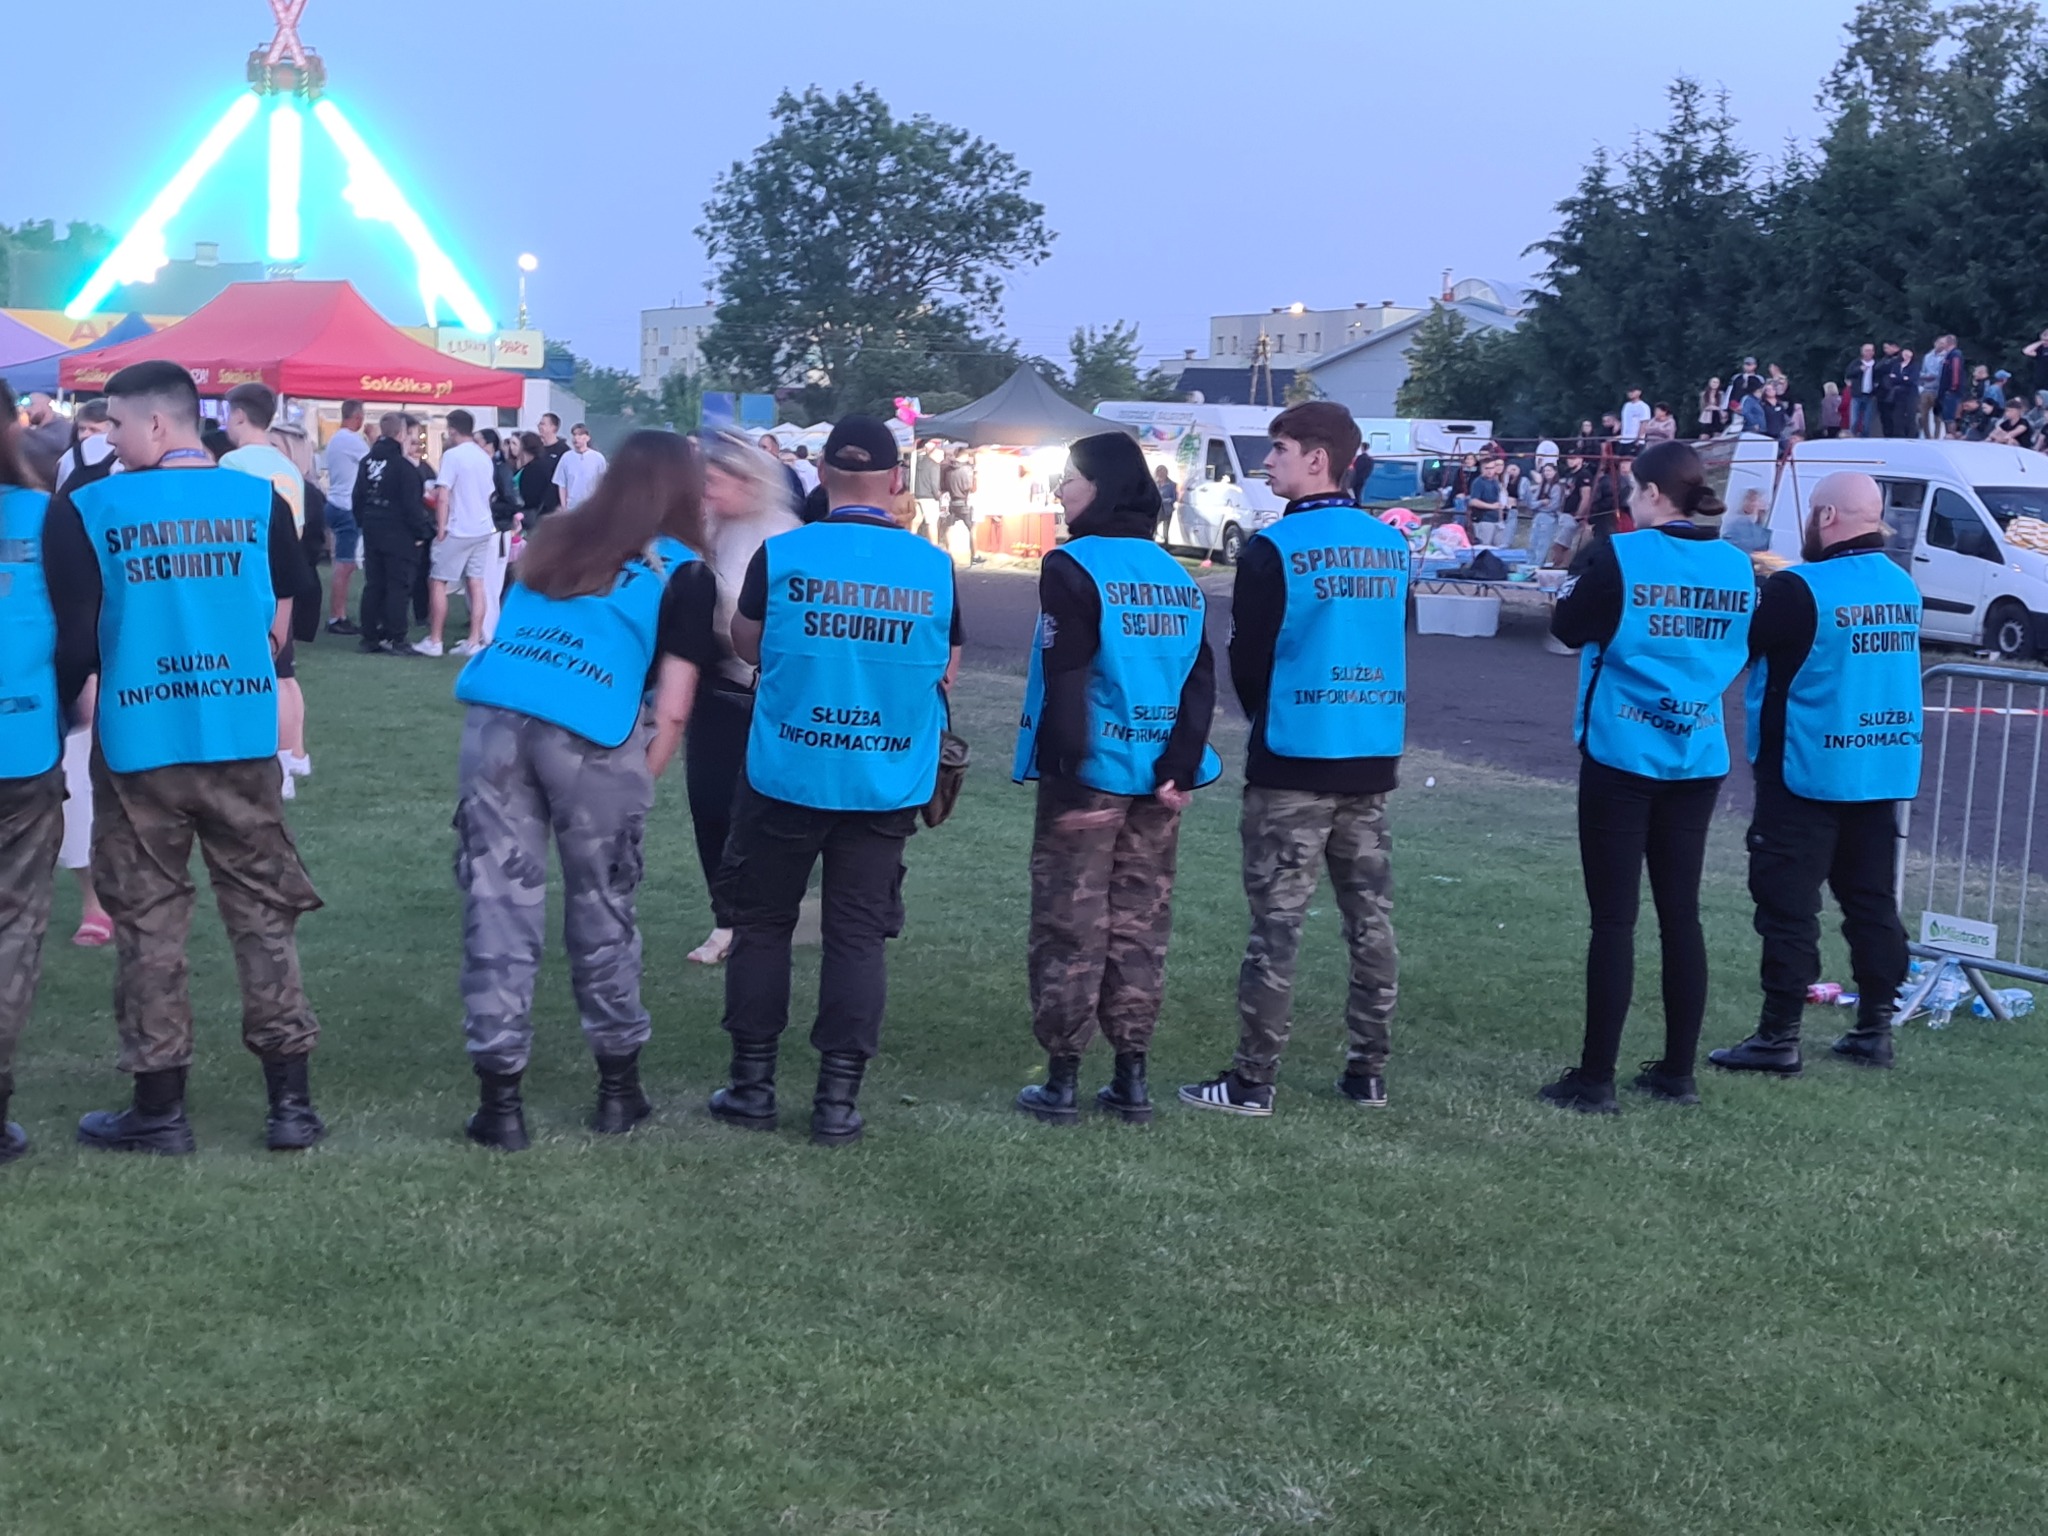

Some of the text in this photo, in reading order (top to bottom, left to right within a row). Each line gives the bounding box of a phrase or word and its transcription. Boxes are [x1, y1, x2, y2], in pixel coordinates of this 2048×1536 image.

[360, 375, 453, 398] Sokółka.pl
[105, 519, 257, 554] SPARTANIE
[126, 552, 242, 584] SECURITY
[1291, 546, 1407, 575] SPARTANIE
[788, 577, 933, 615] SPARTANIE
[1314, 575, 1398, 600] SECURITY
[1633, 584, 1750, 613] SPARTANIE
[804, 611, 914, 645] SECURITY
[1648, 614, 1733, 640] SECURITY
[1852, 631, 1916, 654] SECURITY
[156, 651, 230, 674] SŁUŻBA
[117, 676, 272, 708] INFORMACYJNA
[811, 705, 881, 727] SŁUŻBA
[778, 722, 911, 751] INFORMACYJNA
